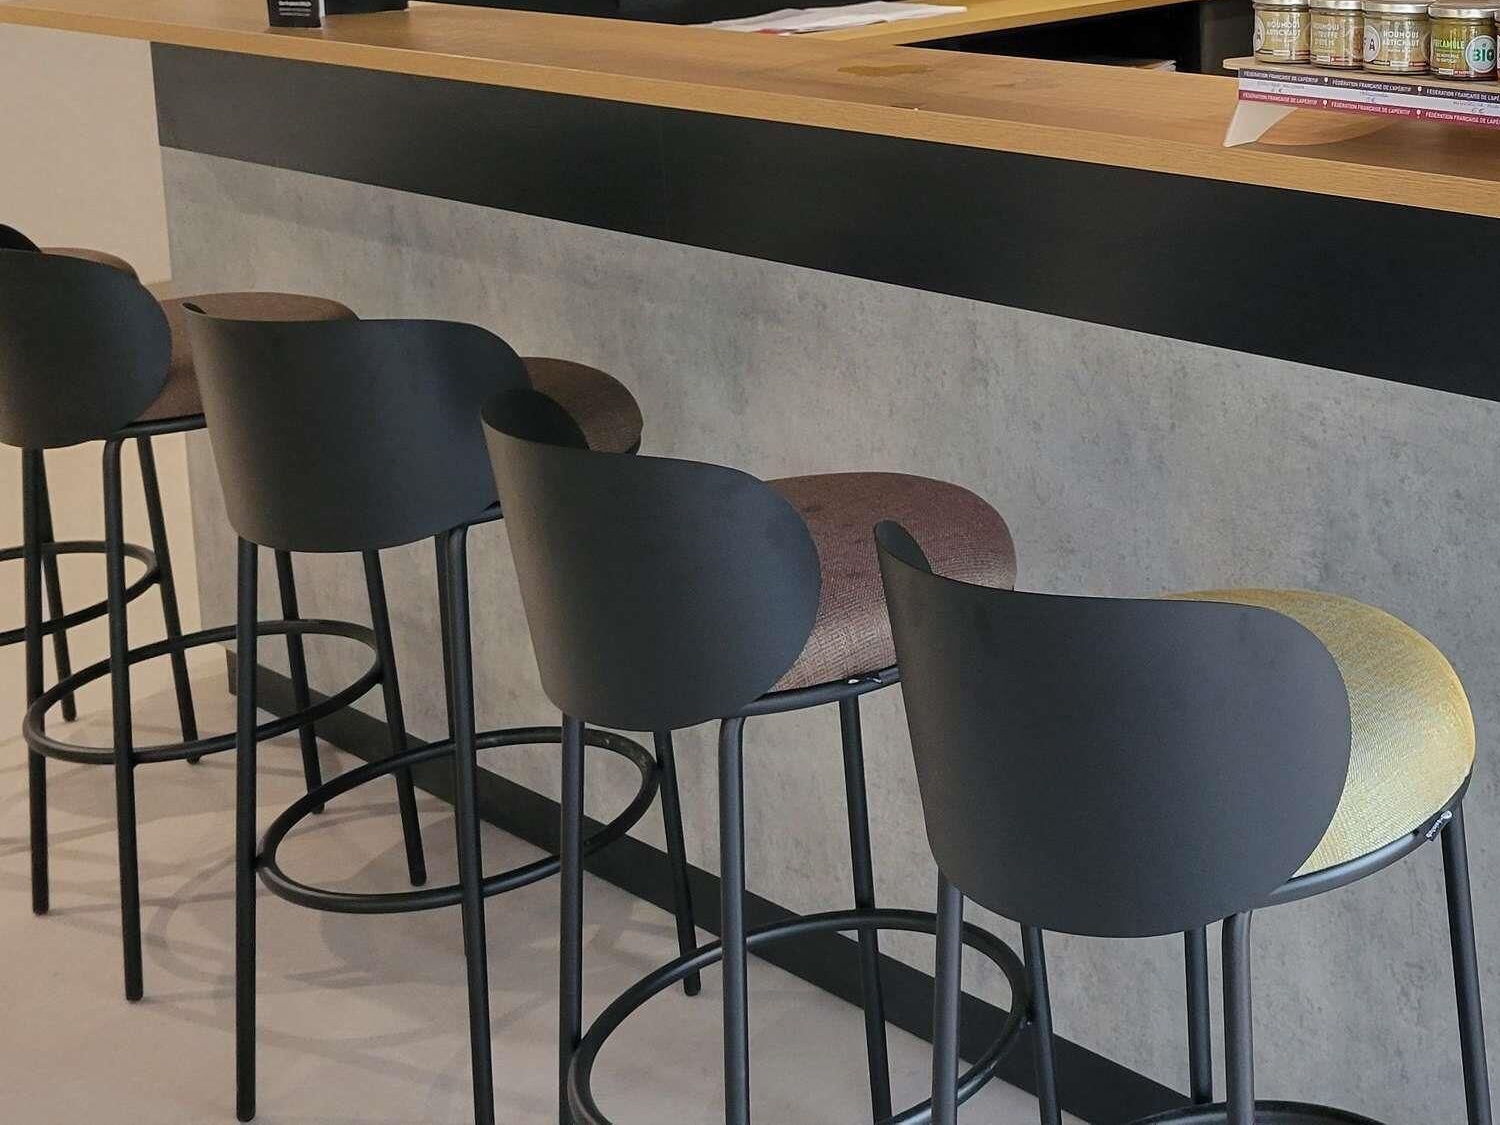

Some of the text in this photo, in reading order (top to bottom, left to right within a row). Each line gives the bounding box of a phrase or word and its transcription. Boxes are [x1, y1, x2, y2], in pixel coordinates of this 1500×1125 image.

[1383, 30, 1420, 38] HOUMOUS
[1382, 38, 1420, 47] ARTICHAUT
[1243, 71, 1268, 79] FÉDÉRATION
[1332, 79, 1358, 87] FÉDÉRATION
[1359, 82, 1382, 90] FRANÇAISE
[1425, 112, 1454, 120] FÉDÉRATION
[1454, 115, 1479, 123] FRANÇAISE
